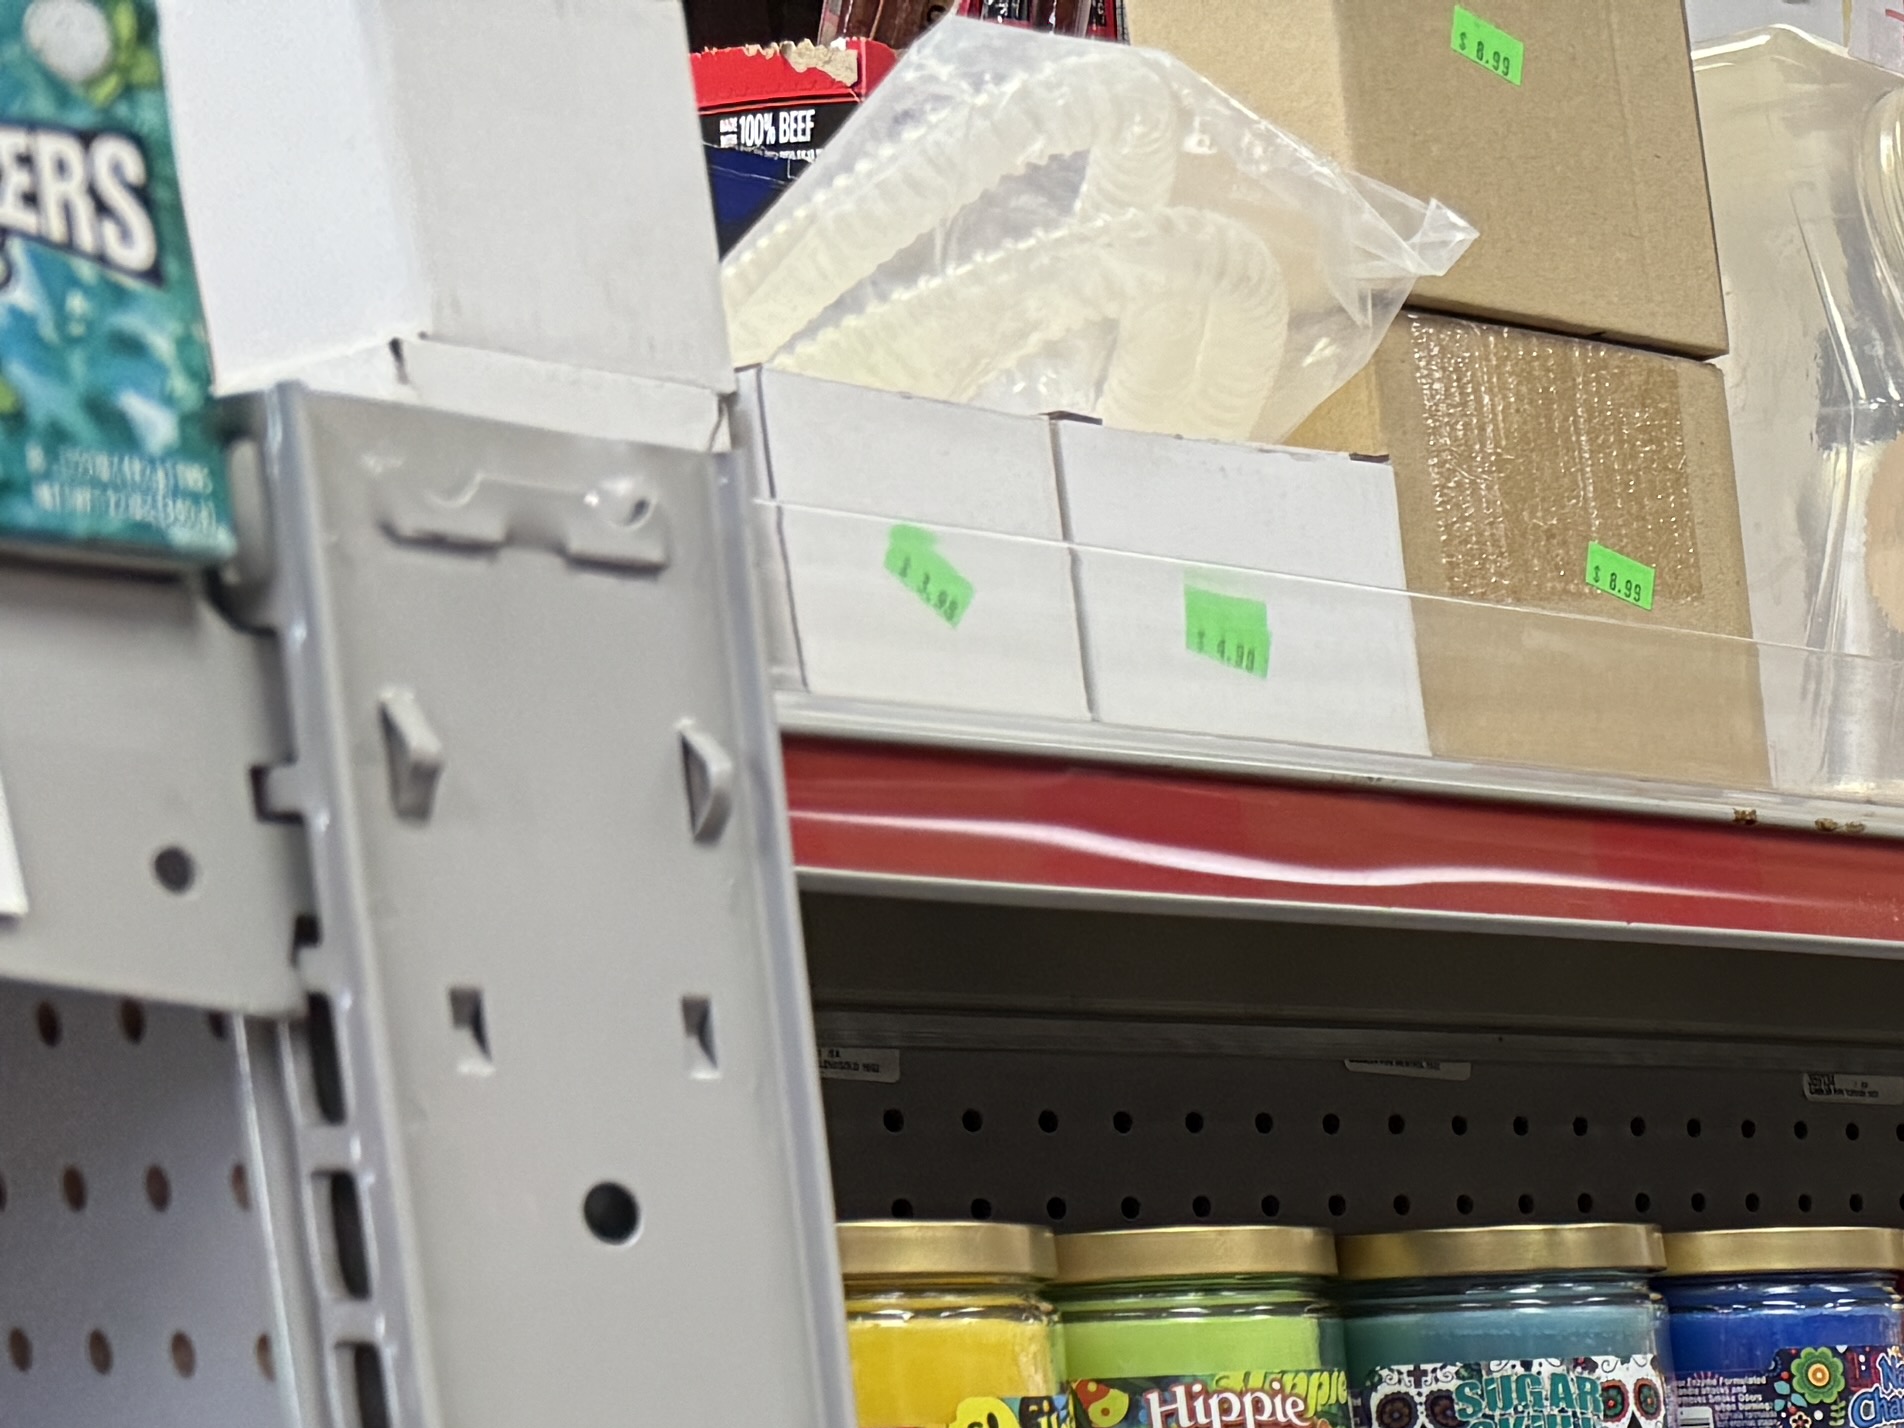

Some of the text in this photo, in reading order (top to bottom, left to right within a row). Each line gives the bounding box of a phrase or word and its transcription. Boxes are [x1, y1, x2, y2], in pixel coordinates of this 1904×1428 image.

[1475, 41, 1510, 76] 8.99
[738, 110, 815, 146] 100% BEEF
[1454, 1371, 1604, 1422] SUGAR
